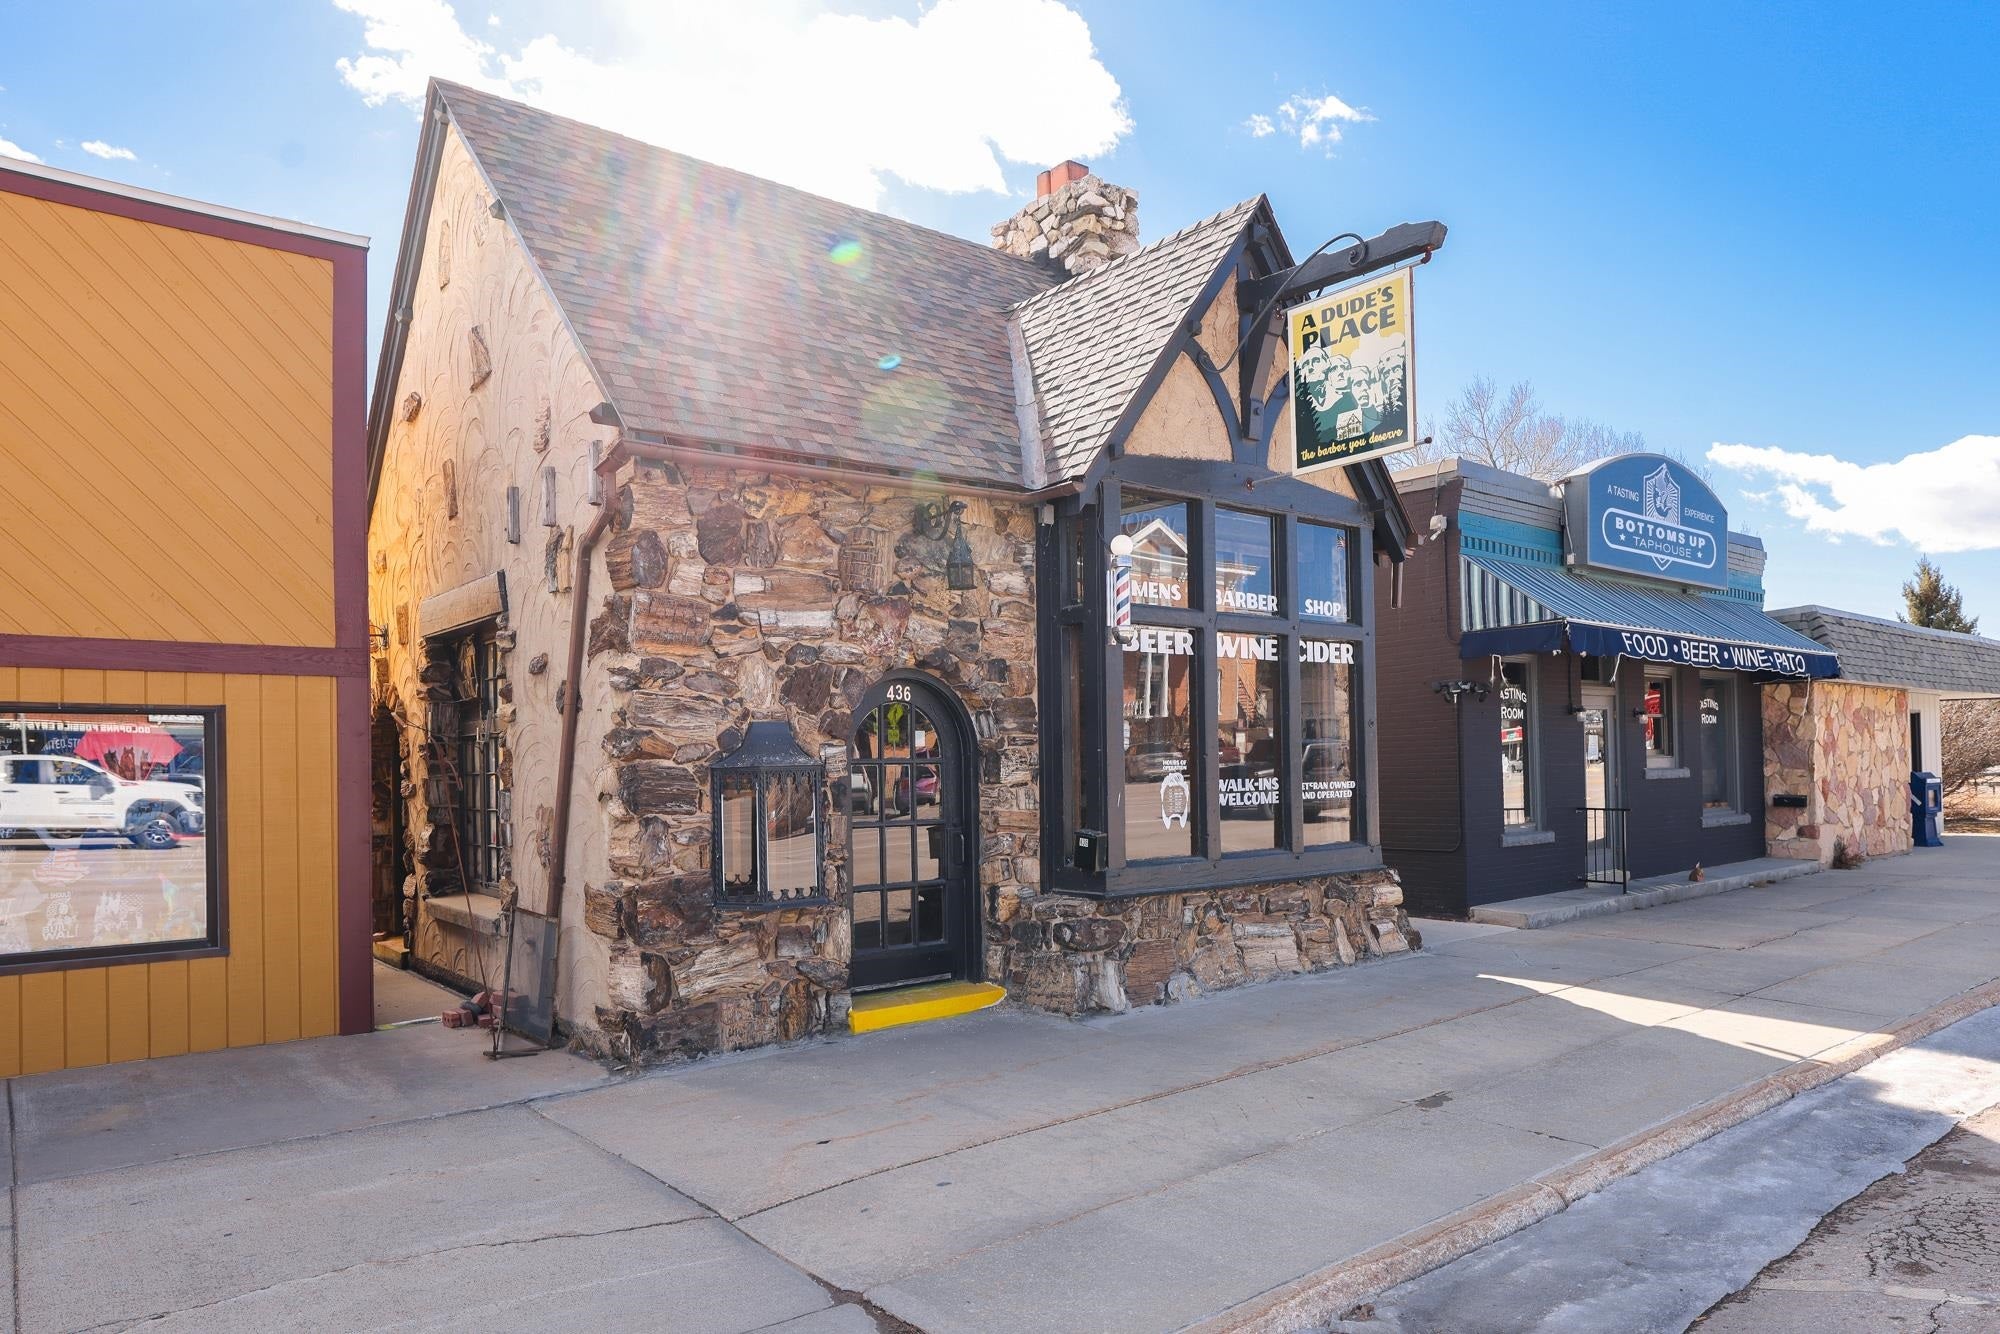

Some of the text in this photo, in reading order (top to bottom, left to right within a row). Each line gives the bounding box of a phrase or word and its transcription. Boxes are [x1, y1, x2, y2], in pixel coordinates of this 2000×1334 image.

[1301, 286, 1394, 331] A DUDE'S
[1302, 304, 1395, 354] PLACE
[1300, 427, 1403, 461] the barber you deserve
[1608, 485, 1715, 523] A TASTING EXPERIENCE
[1615, 517, 1706, 548] BOTTOMS UP
[1633, 536, 1692, 558] TAPHOUSE
[1131, 580, 1182, 601] MENS
[1304, 598, 1342, 617] SHOP
[1122, 629, 1355, 664] BEER WINE CIDER
[1621, 632, 1669, 657] FOOD
[1680, 640, 1720, 664] BEER
[1730, 646, 1772, 668] WINE
[886, 684, 912, 702] 436
[1500, 688, 1527, 703] ASTING
[1500, 706, 1524, 720] ROOM
[1700, 698, 1719, 710] ASTING
[1701, 713, 1717, 724] ROOM
[1219, 777, 1280, 792] WALK-INS
[1329, 780, 1356, 790] OWNED
[1219, 791, 1280, 806] WELCOME
[1316, 790, 1352, 800] OPERATED
